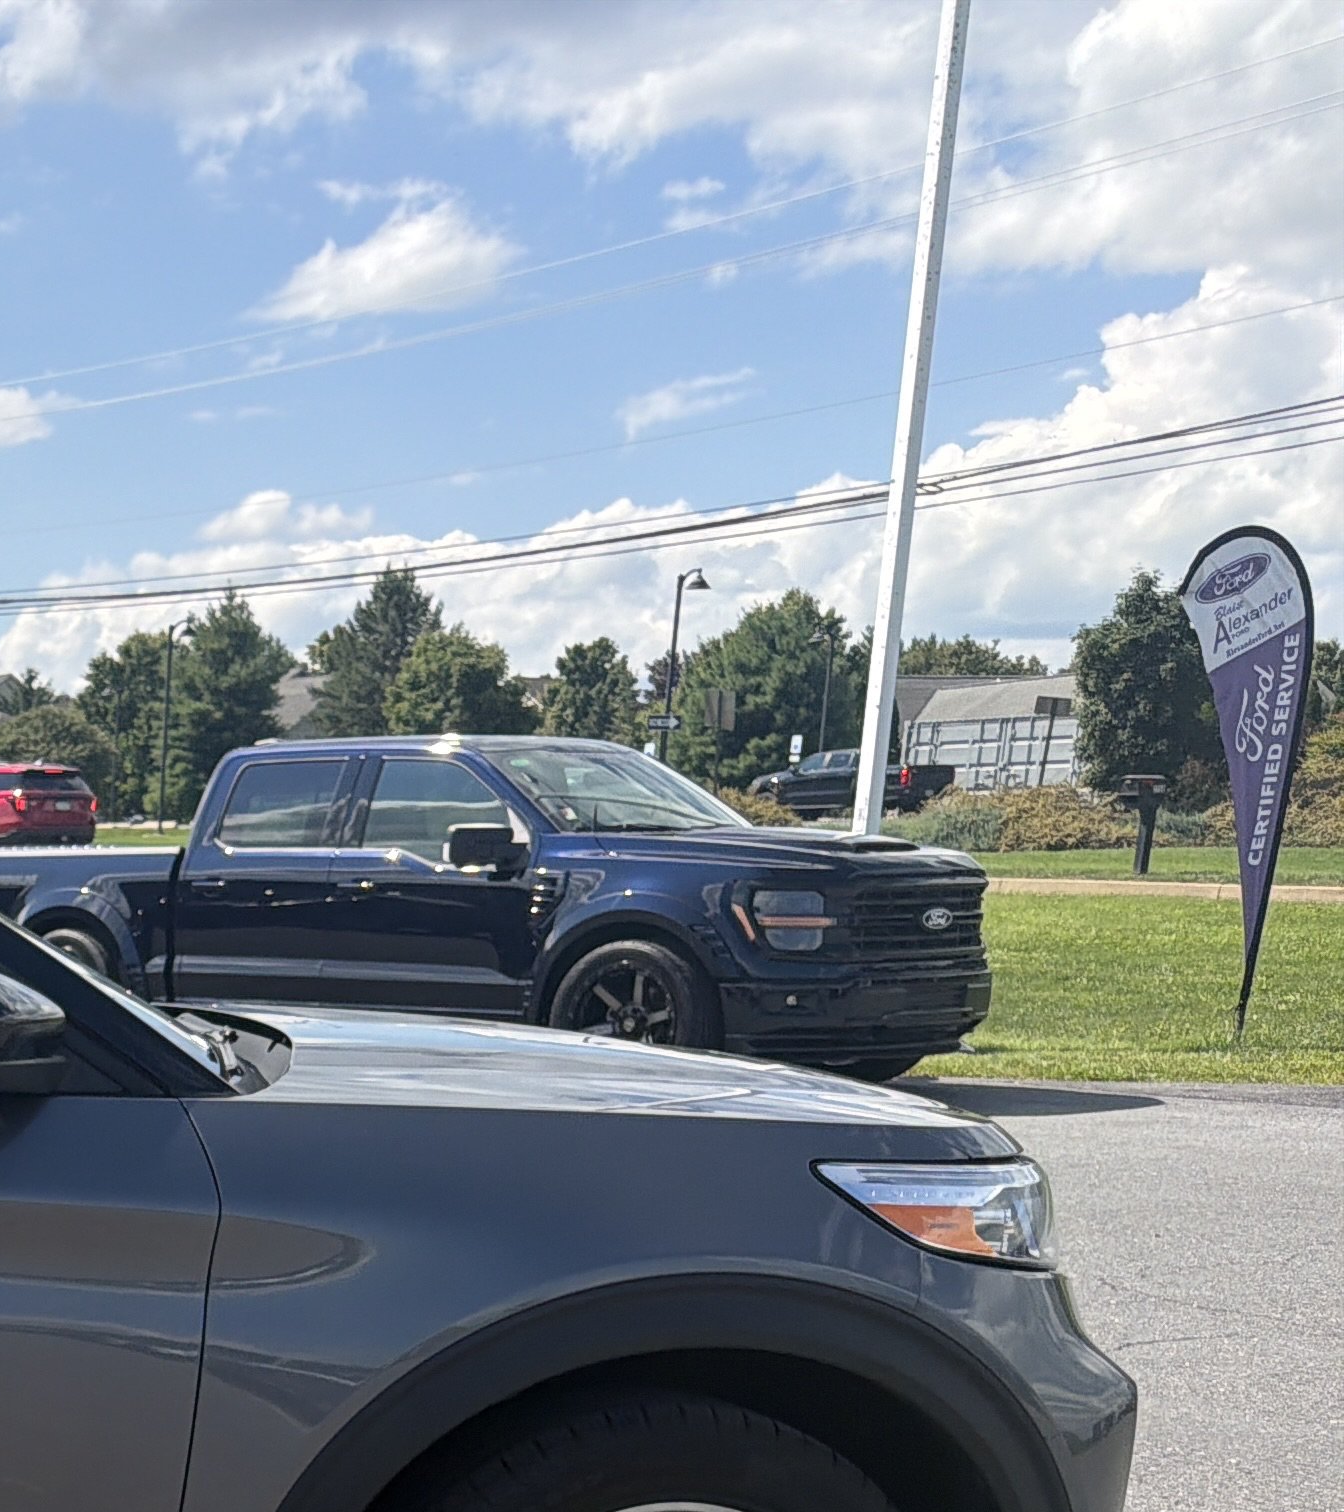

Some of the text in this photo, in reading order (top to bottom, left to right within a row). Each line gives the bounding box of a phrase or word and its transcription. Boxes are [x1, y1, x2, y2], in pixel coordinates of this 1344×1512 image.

[1213, 562, 1255, 596] Ford
[1213, 586, 1294, 655] Alexander
[1235, 663, 1275, 762] Ford
[1248, 632, 1301, 866] CERTIFIED SERVICE
